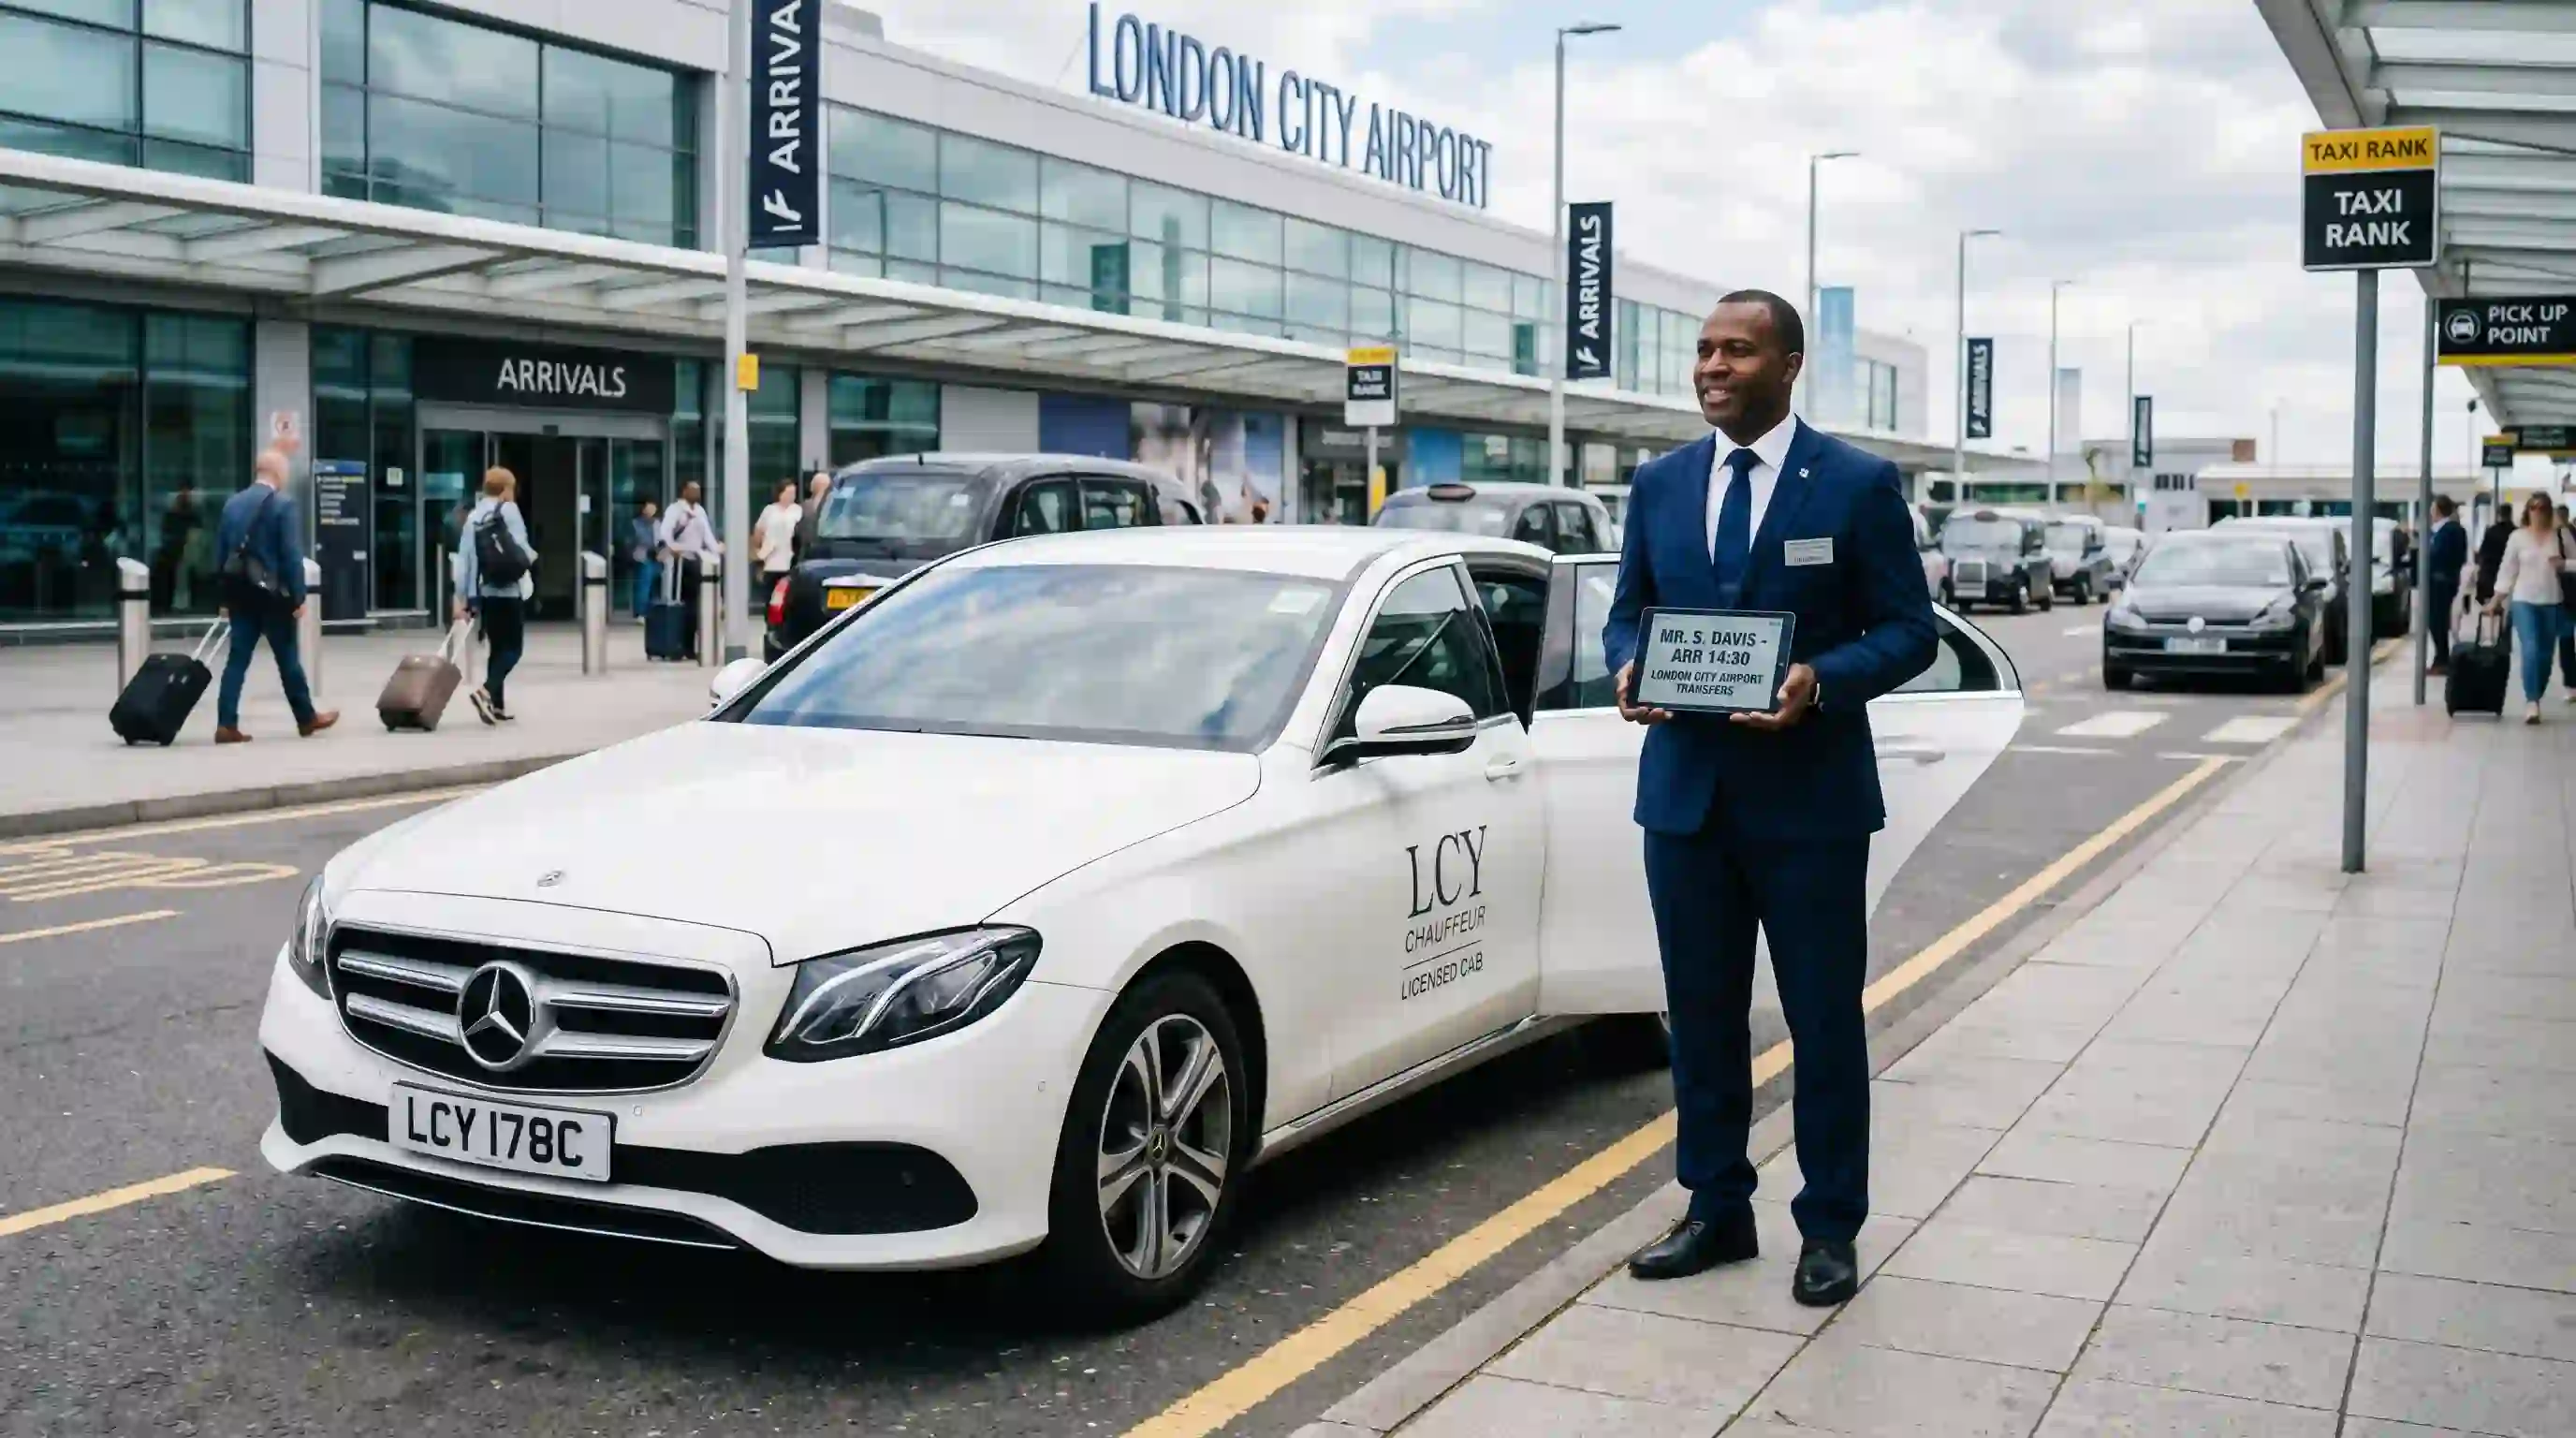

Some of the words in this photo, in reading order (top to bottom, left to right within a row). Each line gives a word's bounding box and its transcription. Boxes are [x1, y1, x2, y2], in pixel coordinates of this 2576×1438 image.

[1089, 2, 1265, 142] LONDON
[1279, 69, 1356, 168] CITY
[1364, 101, 1493, 209] AIRPORT
[2310, 140, 2359, 162] TAXI
[2367, 138, 2428, 159] RANK
[2334, 188, 2403, 215] TAXI
[2326, 221, 2411, 248] RANK
[1579, 214, 1603, 340] ARRIVALS
[2488, 304, 2533, 323] PICK
[2539, 303, 2569, 322] UP
[2488, 326, 2552, 345] POINT
[496, 358, 627, 398] ARRIVALS
[1661, 628, 1688, 645] MR.
[1691, 630, 1706, 645] S.
[1711, 631, 1757, 647] DAVIS
[1671, 648, 1704, 664] ARR
[1709, 651, 1751, 666] 14:30
[1650, 669, 1692, 682] LONDON
[1694, 671, 1717, 682] CITY
[1719, 672, 1764, 684] AIRPORT
[1676, 682, 1734, 696] TRANSFERS
[1405, 824, 1487, 919] LCY
[1405, 905, 1486, 954] CHAUFFEUR
[1401, 962, 1458, 1001] LICENSED
[1460, 951, 1485, 977] CAB
[407, 1096, 476, 1152] LCY
